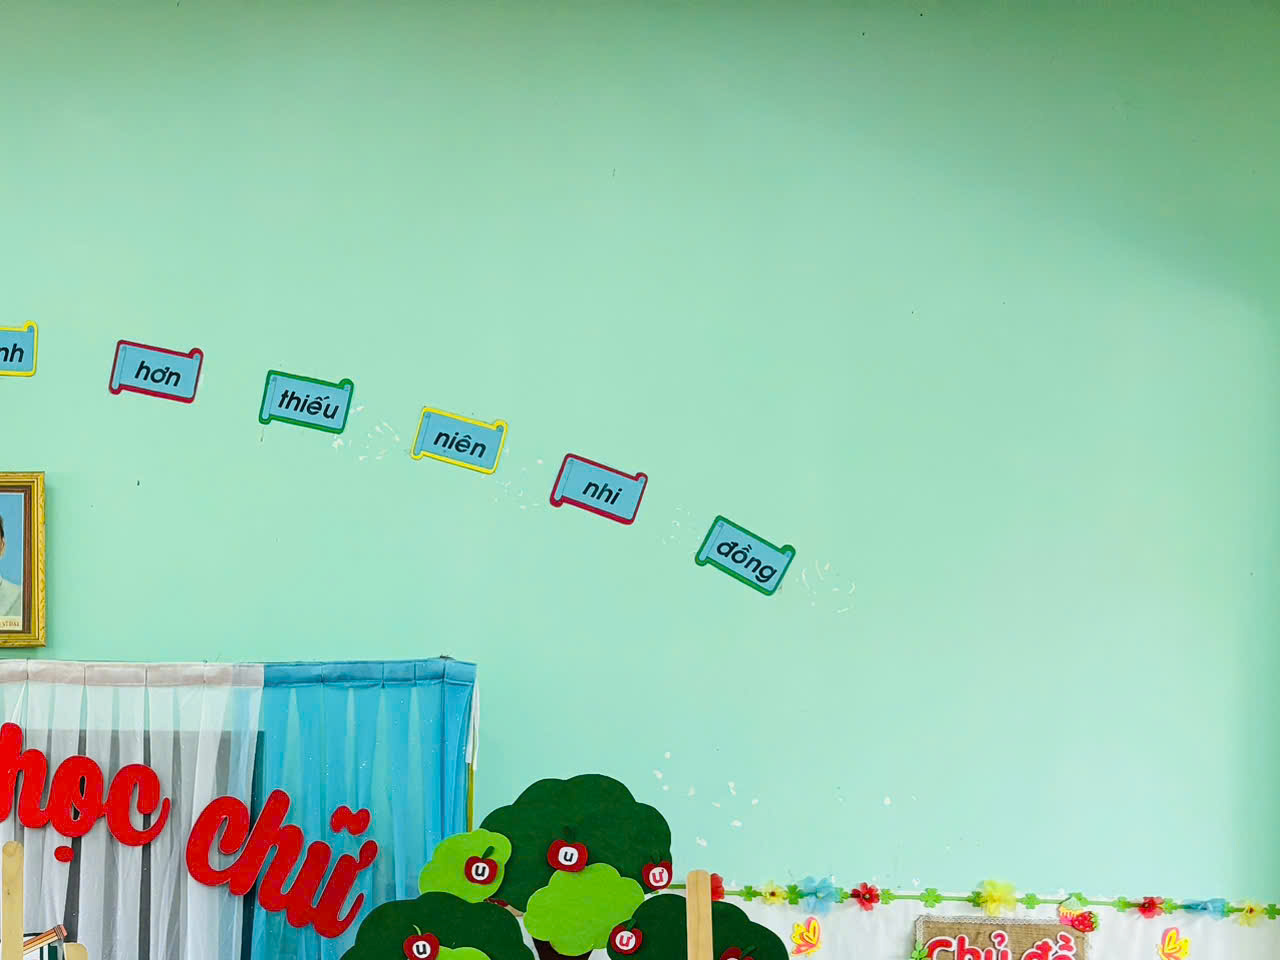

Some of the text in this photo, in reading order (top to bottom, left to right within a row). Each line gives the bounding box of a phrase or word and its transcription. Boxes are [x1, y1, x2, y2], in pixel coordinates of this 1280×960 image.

[134, 360, 181, 386] hơn
[278, 390, 339, 419] thiếu
[433, 430, 486, 458] niên
[582, 480, 622, 505] nhi
[716, 541, 777, 583] đồng
[185, 788, 379, 938] chữ
[563, 851, 574, 863] u
[474, 864, 487, 878] u
[415, 943, 427, 956] u
